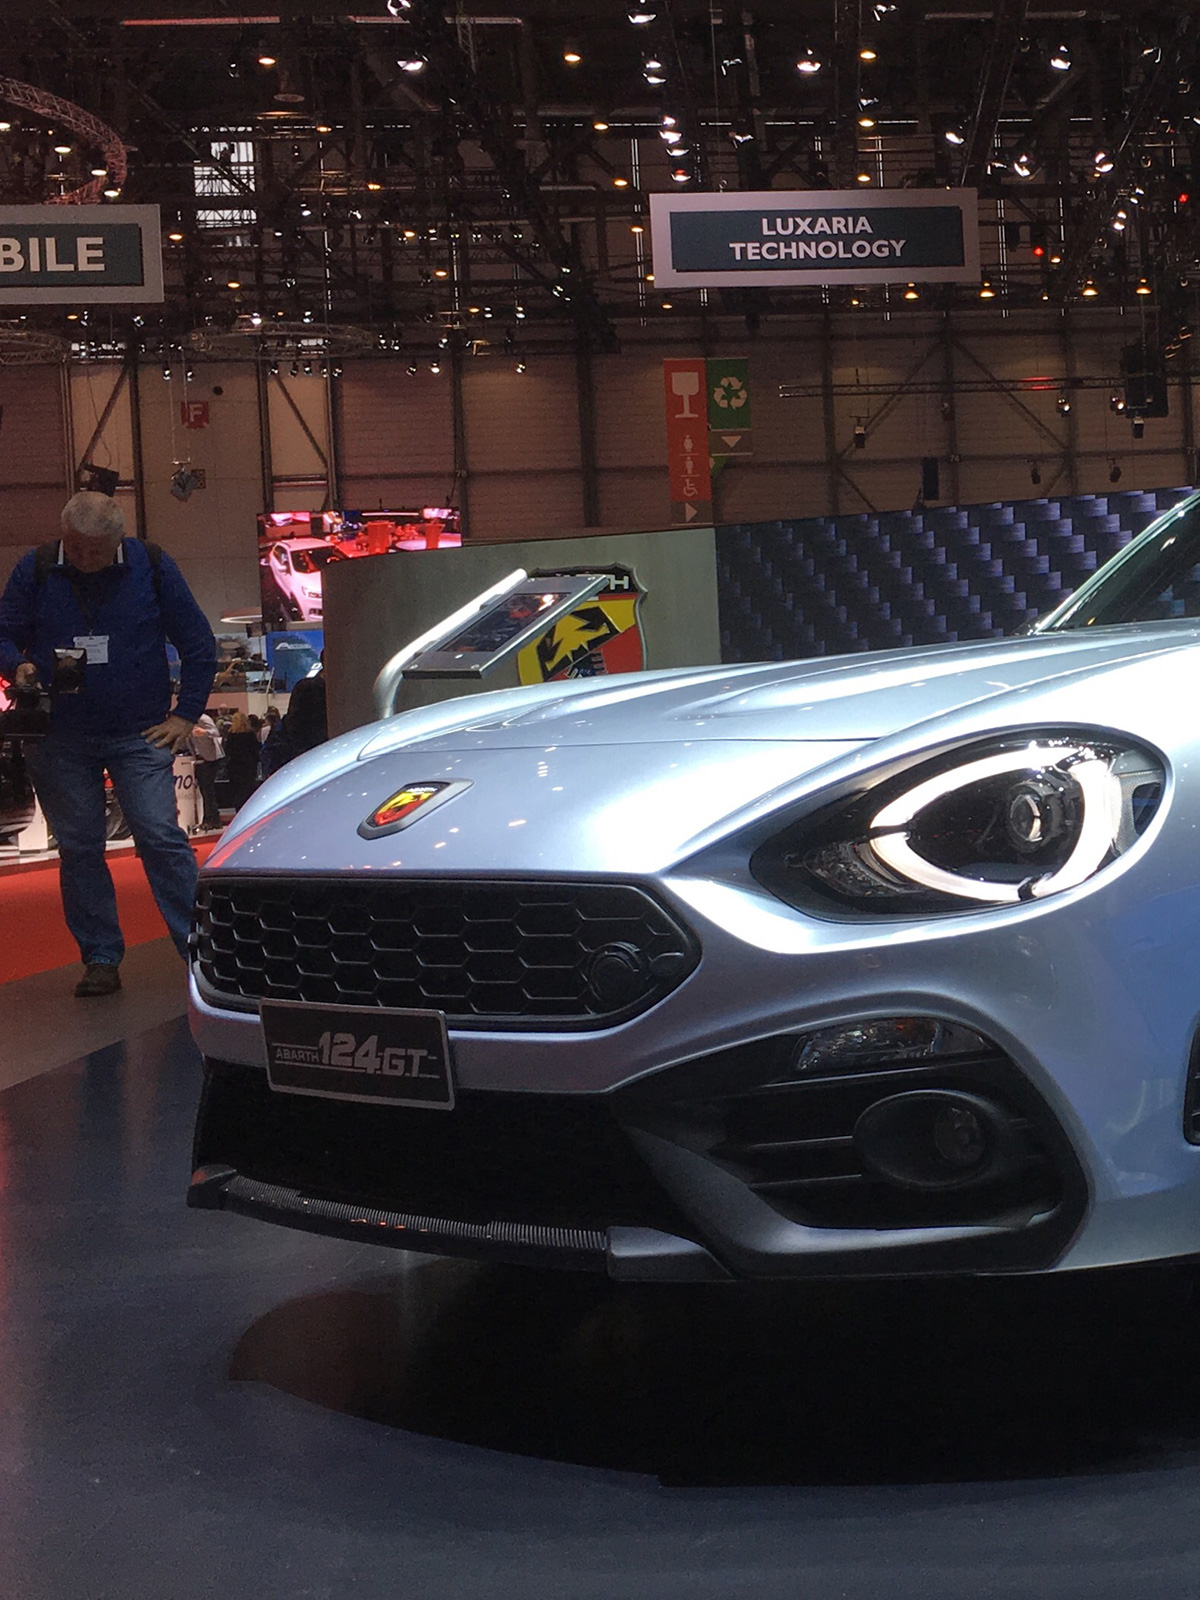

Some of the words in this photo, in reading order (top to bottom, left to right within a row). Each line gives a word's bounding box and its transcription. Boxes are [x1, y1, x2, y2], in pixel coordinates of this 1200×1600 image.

[762, 216, 873, 236] LUXARIA
[0, 237, 105, 272] BILE
[729, 240, 906, 260] TECHNOLOGY
[189, 404, 203, 422] F
[276, 1048, 319, 1062] ABARTH
